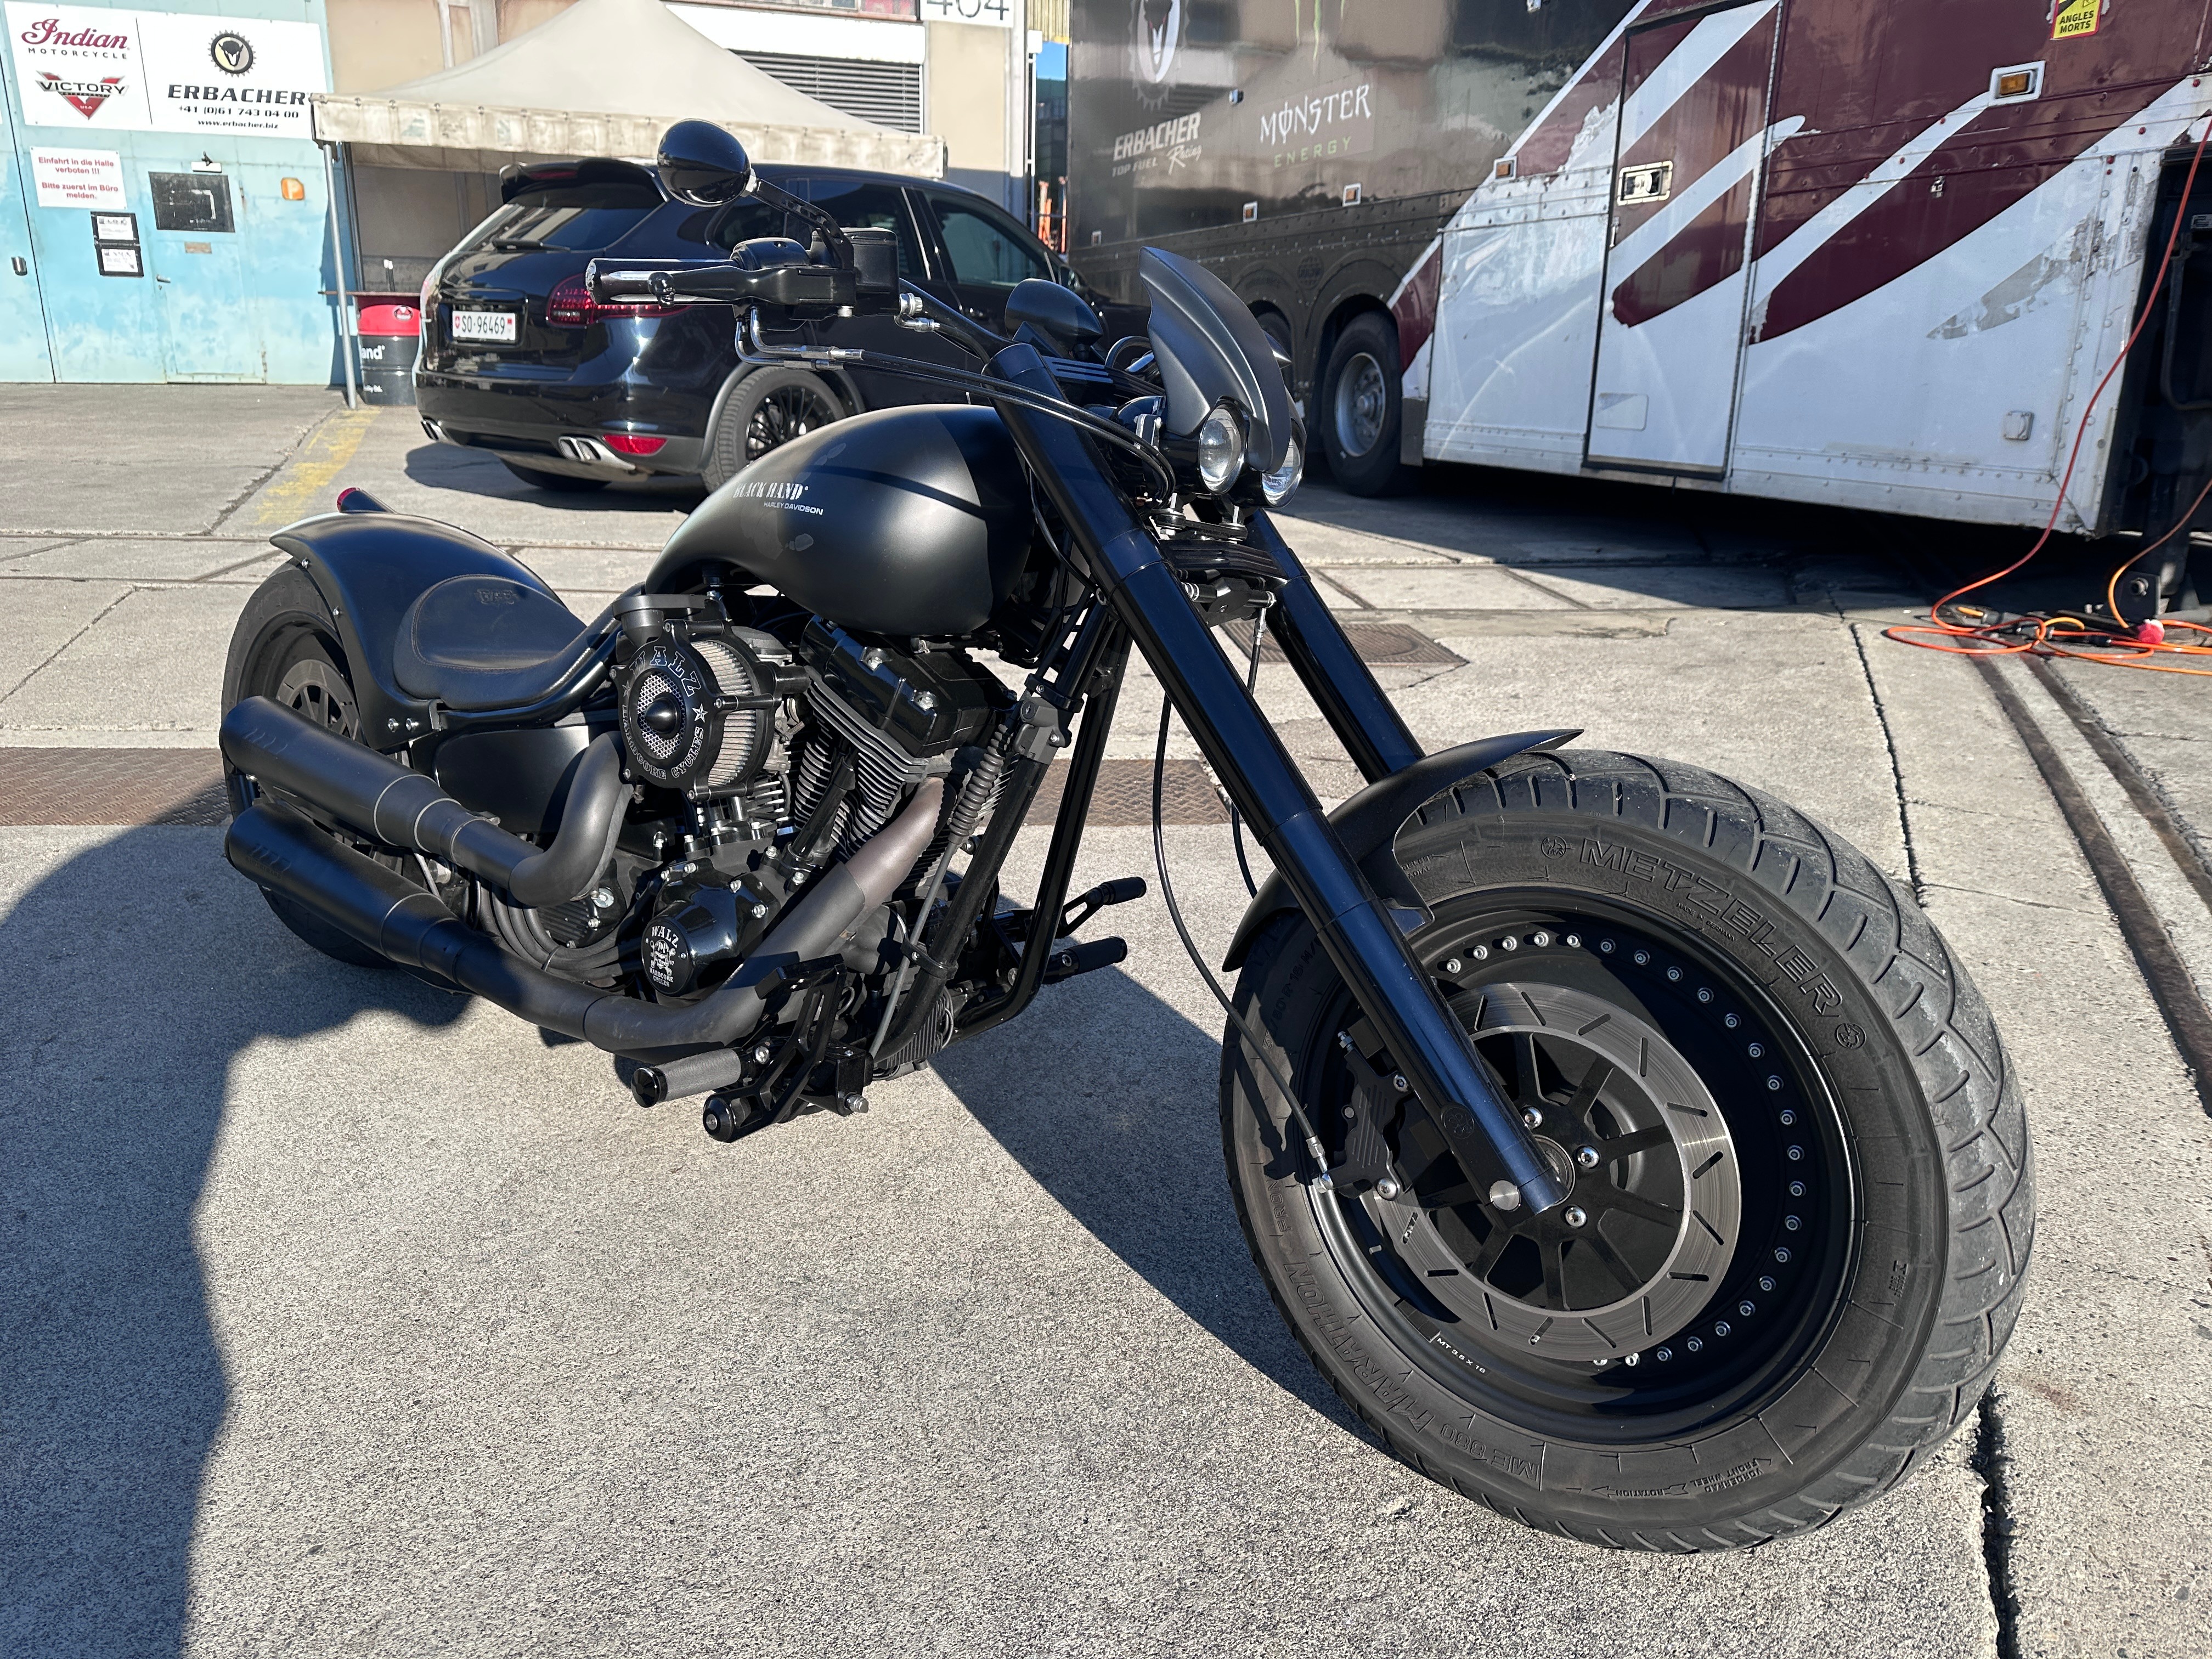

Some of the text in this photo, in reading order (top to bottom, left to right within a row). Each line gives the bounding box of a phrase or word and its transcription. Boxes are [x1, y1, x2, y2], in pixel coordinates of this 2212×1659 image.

[2059, 10, 2095, 25] ANGLES
[2060, 20, 2091, 33] MORTS
[21, 19, 128, 49] Indian
[28, 47, 127, 59] MOTORCYCLE
[40, 81, 126, 94] VICTORY
[167, 84, 306, 105] ERBACHER
[204, 106, 232, 115] (0)61
[238, 108, 260, 116] 743
[264, 109, 280, 117] 04
[284, 110, 299, 119] 00
[198, 120, 279, 129] www.erbacher.biz
[1113, 111, 1201, 161] ERBACHER
[38, 156, 70, 165] Einfahrt
[1274, 136, 1351, 168] ENERGY
[1132, 157, 1158, 172] FUEL
[732, 482, 767, 498] BLACK
[784, 503, 823, 516] DAVIDSON
[629, 646, 702, 697] WALZ
[622, 704, 667, 780] HARDCORE
[671, 726, 704, 778] CYCLES
[651, 926, 679, 949] WALZ
[1581, 838, 1843, 1016] METZELER
[649, 967, 674, 983] HARDCORE
[653, 975, 670, 988] CYCLES
[1283, 1262, 1435, 1433] MARATHON
[1437, 1338, 1452, 1348] MT
[1475, 1365, 1486, 1373] 16
[1440, 1423, 1539, 1482] ME 880
[1693, 1458, 1759, 1487] FRONT WHEEL
[1704, 1467, 1764, 1493] VORDERRAD
[1615, 1488, 1664, 1497] ROTATION
